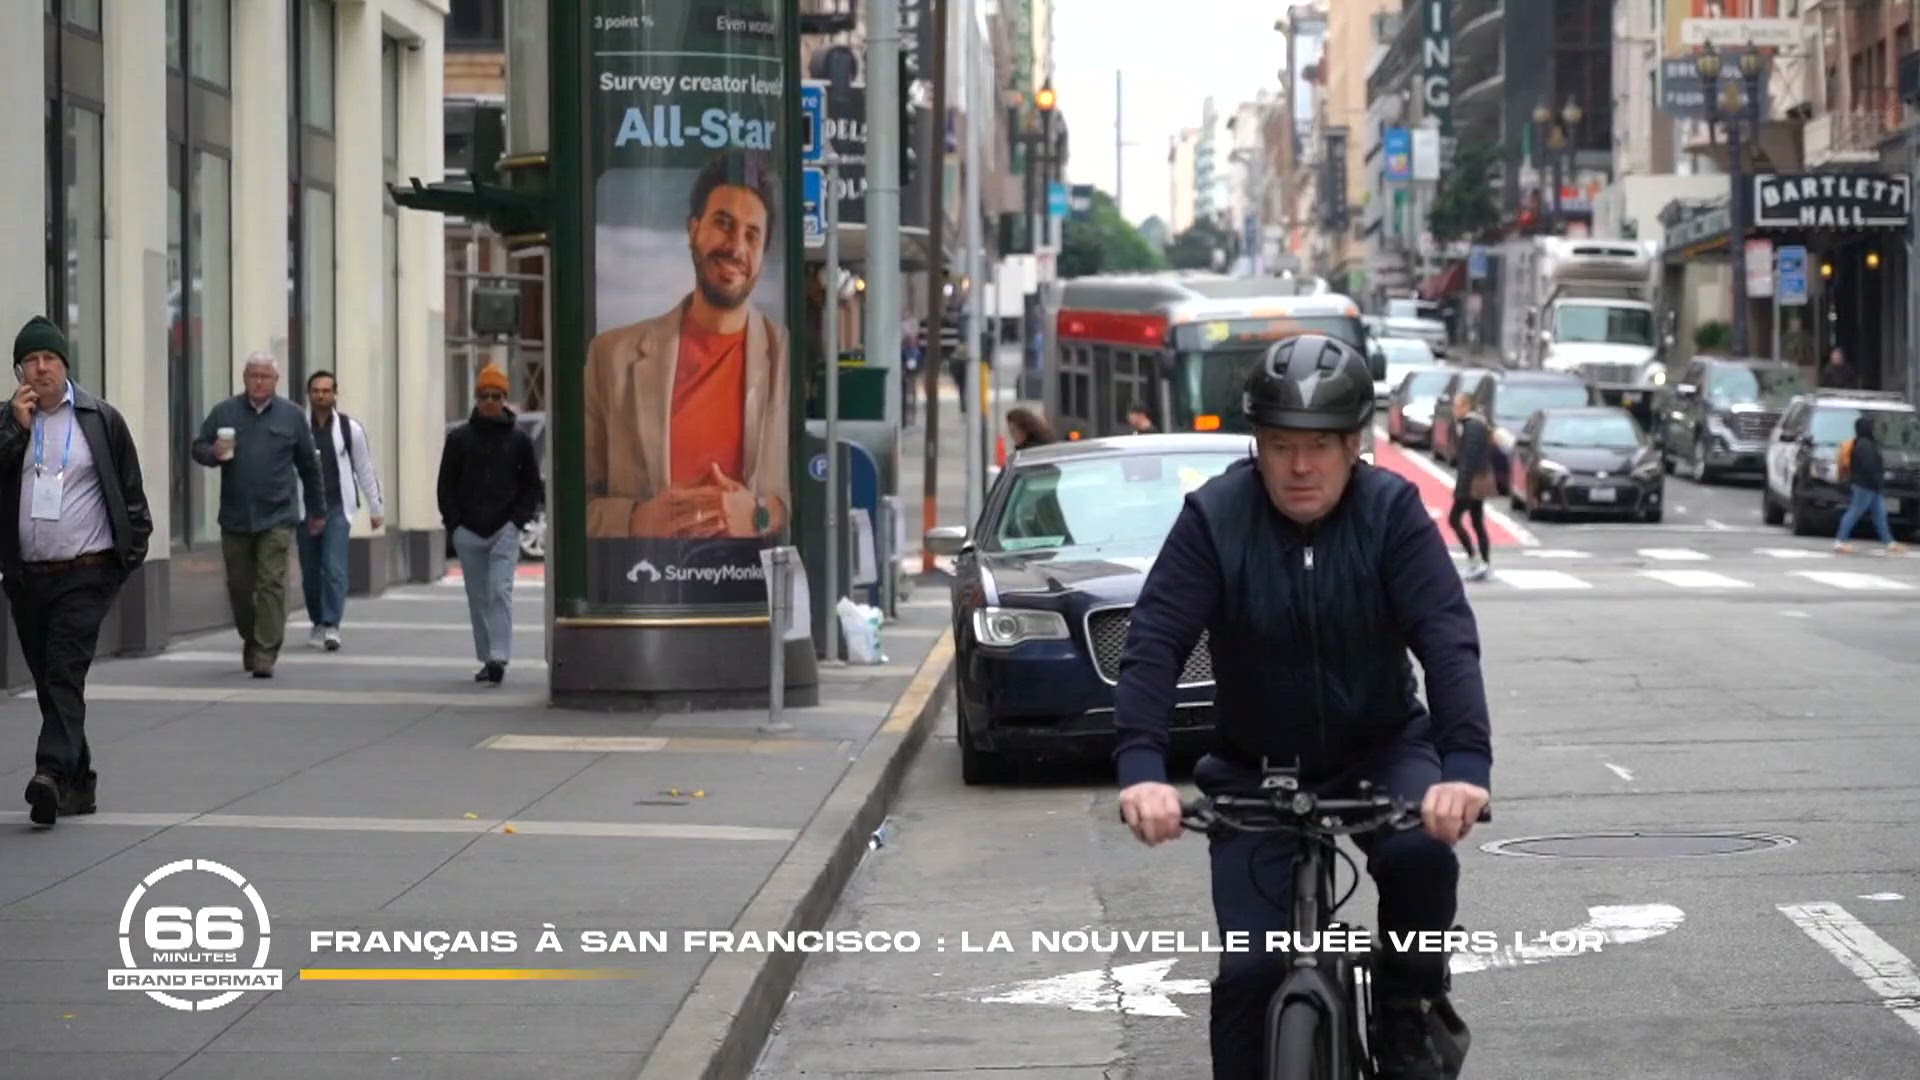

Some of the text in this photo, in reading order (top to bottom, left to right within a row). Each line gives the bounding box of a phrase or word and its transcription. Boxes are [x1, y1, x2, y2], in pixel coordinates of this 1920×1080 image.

[594, 16, 602, 29] 3
[605, 16, 639, 32] point
[716, 15, 747, 32] Even
[599, 71, 675, 96] Survey
[679, 73, 748, 94] creator
[614, 104, 776, 151] All-Star
[1762, 176, 1904, 208] BARTLETT
[1798, 205, 1866, 226] HALL
